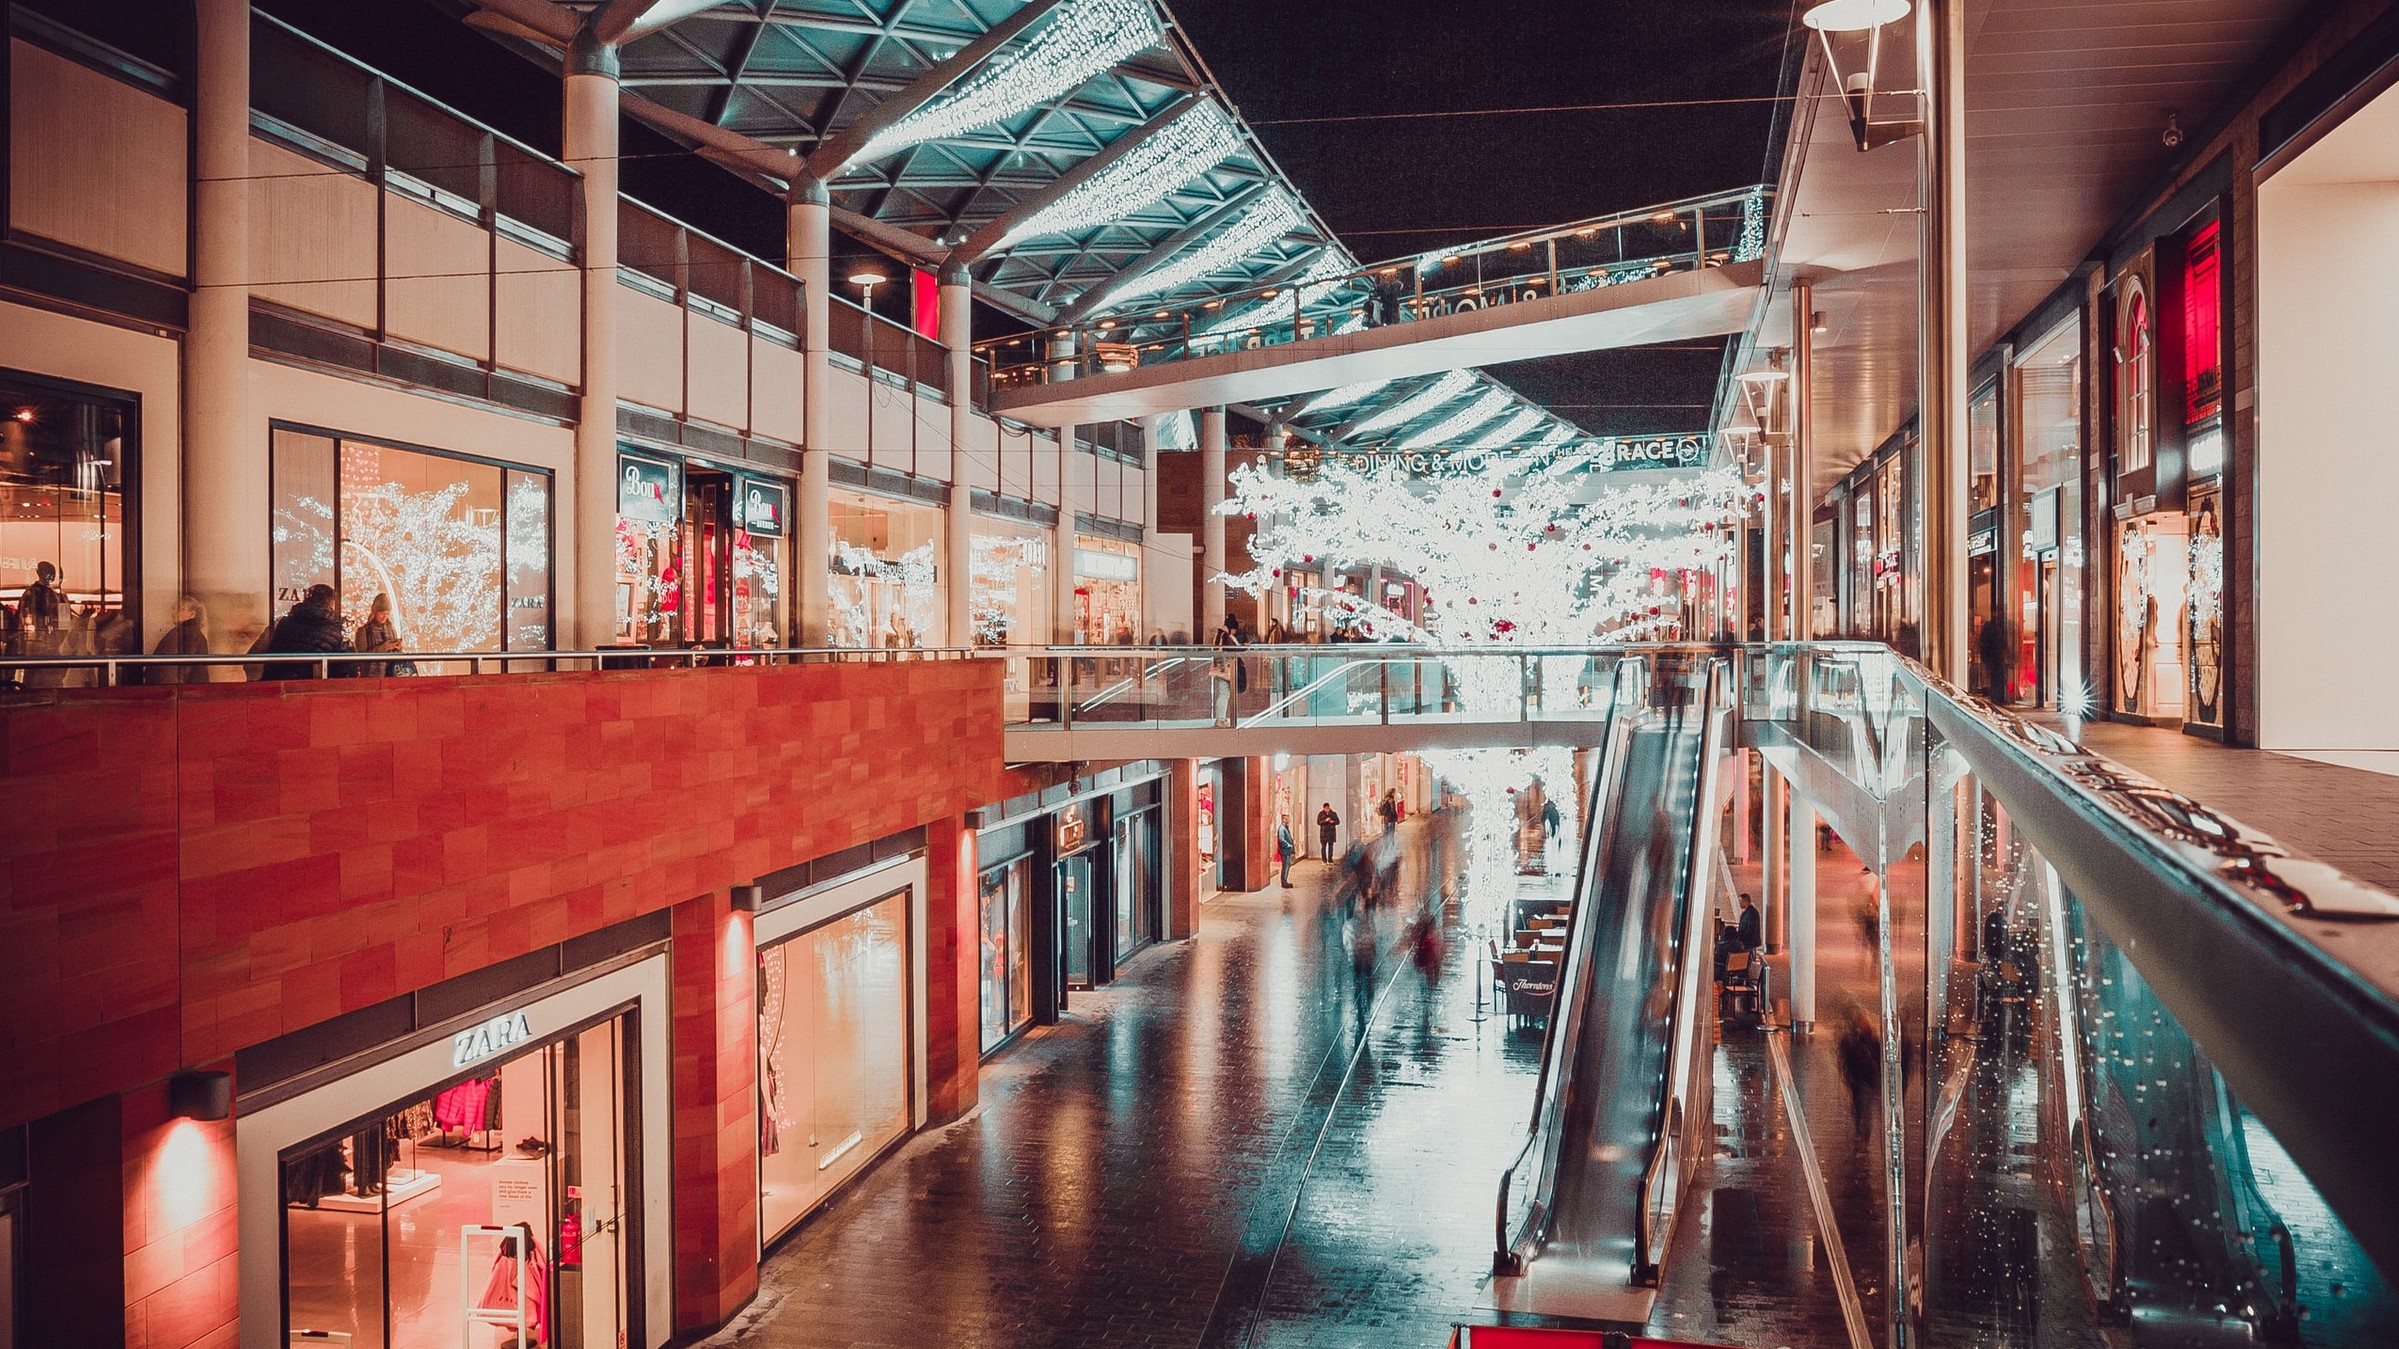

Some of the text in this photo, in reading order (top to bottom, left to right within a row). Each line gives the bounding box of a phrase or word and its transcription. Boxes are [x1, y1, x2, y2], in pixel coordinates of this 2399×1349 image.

[1432, 453, 1445, 471] &
[865, 563, 905, 575] WAREHOUS
[511, 596, 543, 609] ZARA
[1512, 978, 1554, 991] Thorntons
[456, 1013, 532, 1065] ZARA
